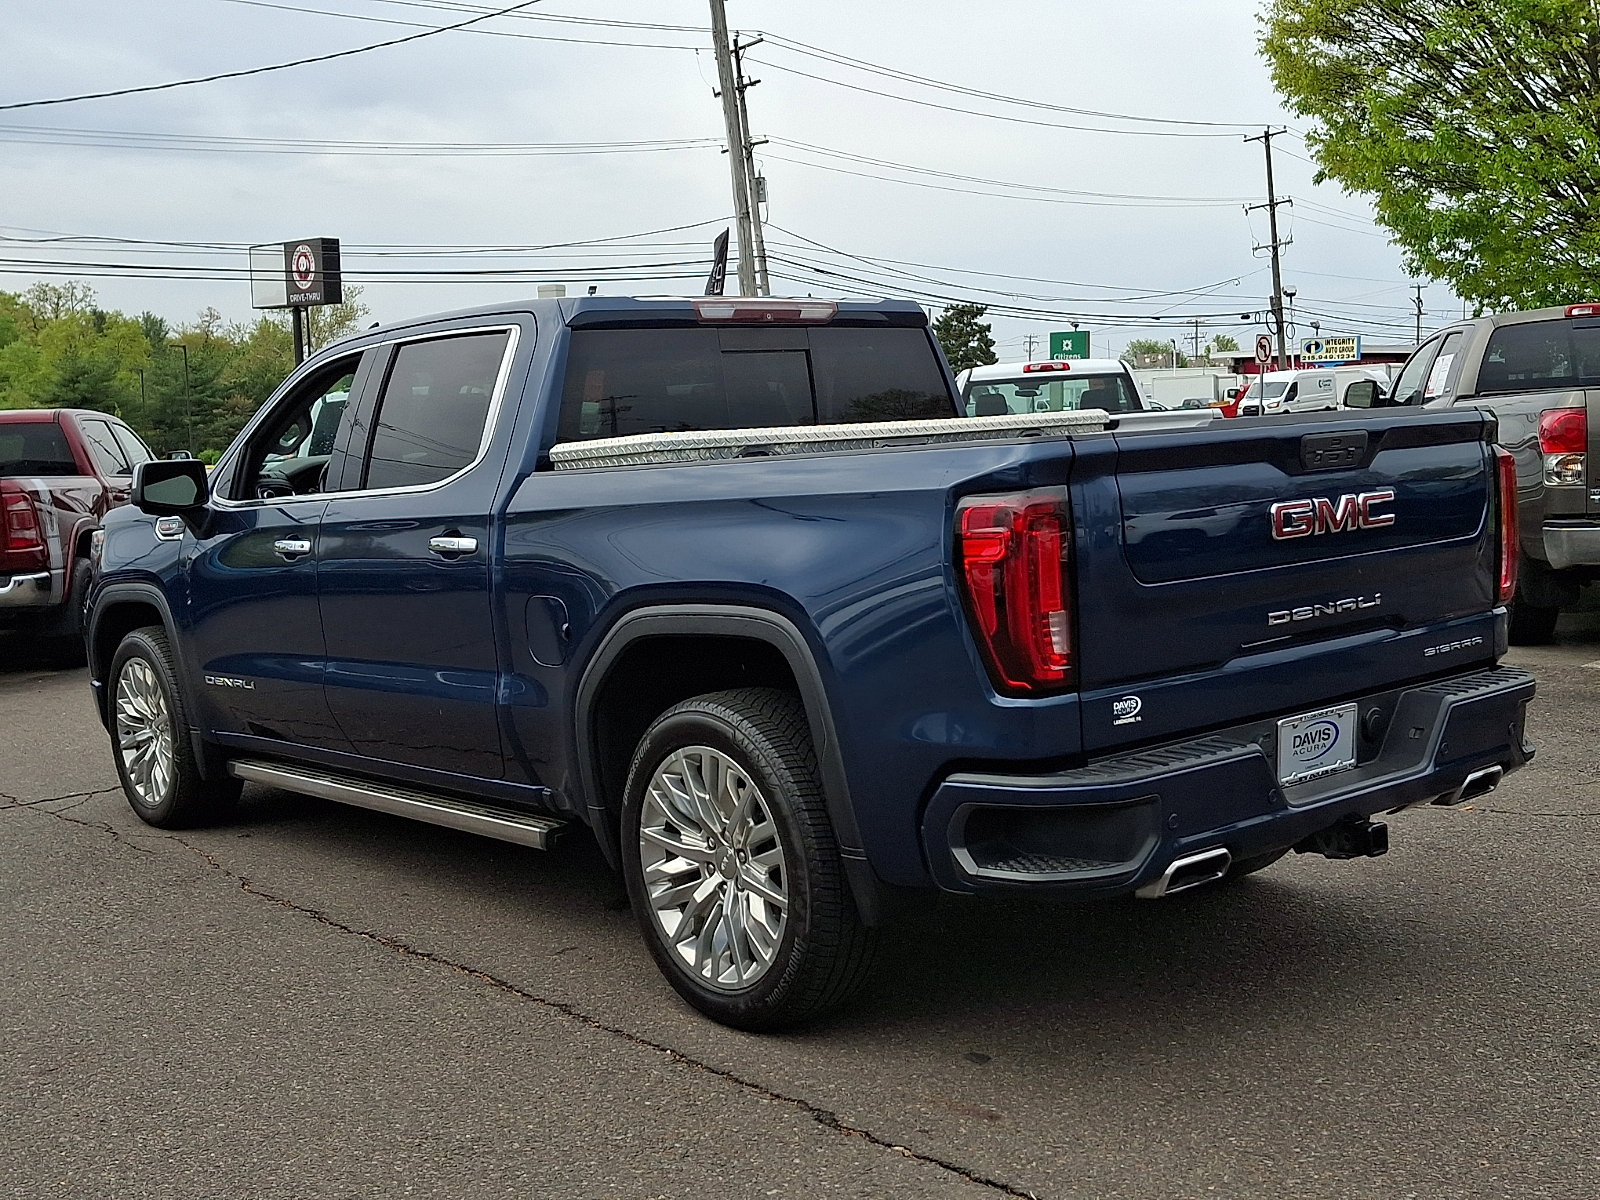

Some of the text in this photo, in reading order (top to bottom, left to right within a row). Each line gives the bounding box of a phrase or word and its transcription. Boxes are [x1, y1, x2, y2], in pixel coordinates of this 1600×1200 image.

[290, 292, 321, 303] DRIVE-THRU
[1325, 337, 1355, 345] INTEGRITY
[1325, 345, 1355, 354] AUTO GROUP
[1053, 352, 1082, 361] Citizens
[1270, 490, 1396, 541] GMC
[1267, 592, 1382, 626] DENALI
[1424, 636, 1484, 657] SIERRA
[204, 675, 256, 690] DENALI
[1113, 699, 1137, 711] DAVIS
[1113, 706, 1135, 716] ACURA
[1293, 728, 1331, 749] DAVIS
[1292, 743, 1327, 757] ACURA
